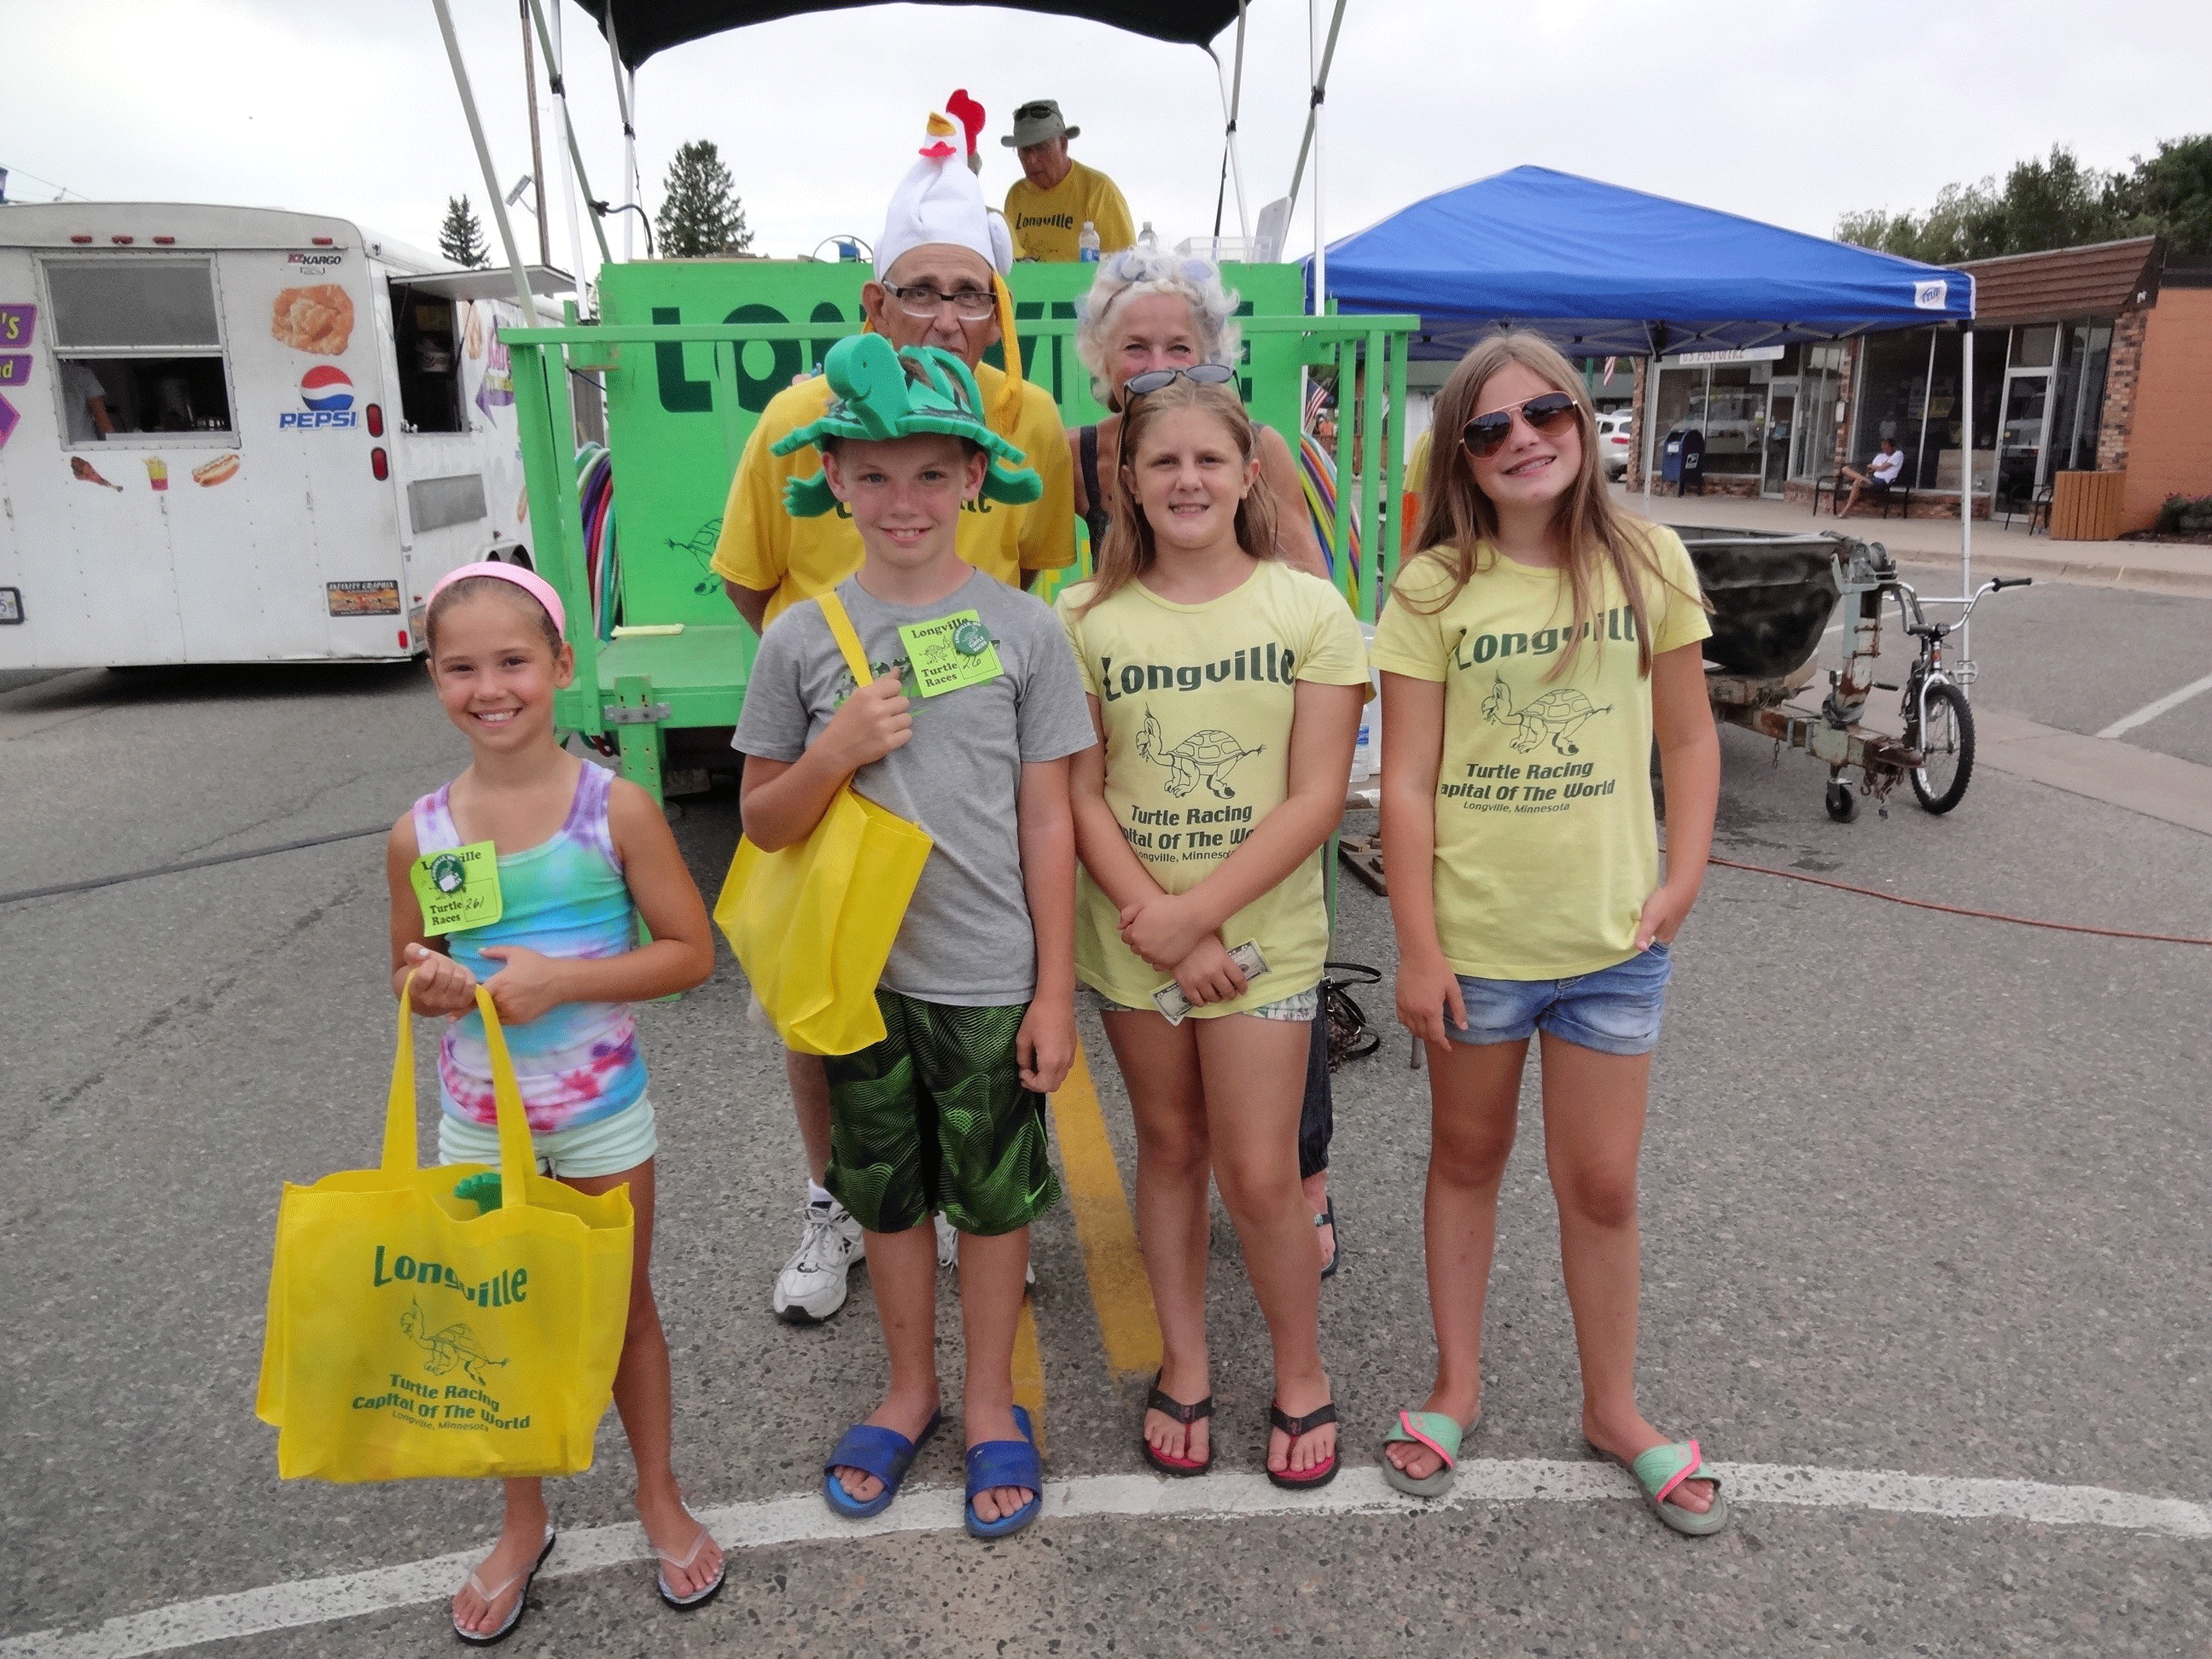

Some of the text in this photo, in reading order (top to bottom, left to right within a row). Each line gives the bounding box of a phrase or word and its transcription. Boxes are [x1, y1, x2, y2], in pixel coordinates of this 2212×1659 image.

[1015, 212, 1074, 230] Longville
[279, 411, 357, 428] PEPSI
[911, 617, 969, 639] Longville
[921, 662, 958, 678] Turtle
[1101, 642, 1295, 702] Longville
[925, 673, 958, 688] Races
[1465, 761, 1595, 780] Turtle Racing
[1441, 778, 1617, 802] apital Of The World
[1131, 805, 1253, 827] Turtle Racing
[1463, 800, 1571, 814] Longville, Minnesota
[1121, 825, 1153, 848] pital
[1158, 832, 1182, 850] Of
[1185, 830, 1224, 849] The
[428, 900, 463, 915] Turtle
[431, 914, 462, 927] Races
[389, 1373, 500, 1413] Turtle Racing
[352, 1392, 532, 1430] Capital Of The World
[437, 1420, 490, 1433] Minnesota
